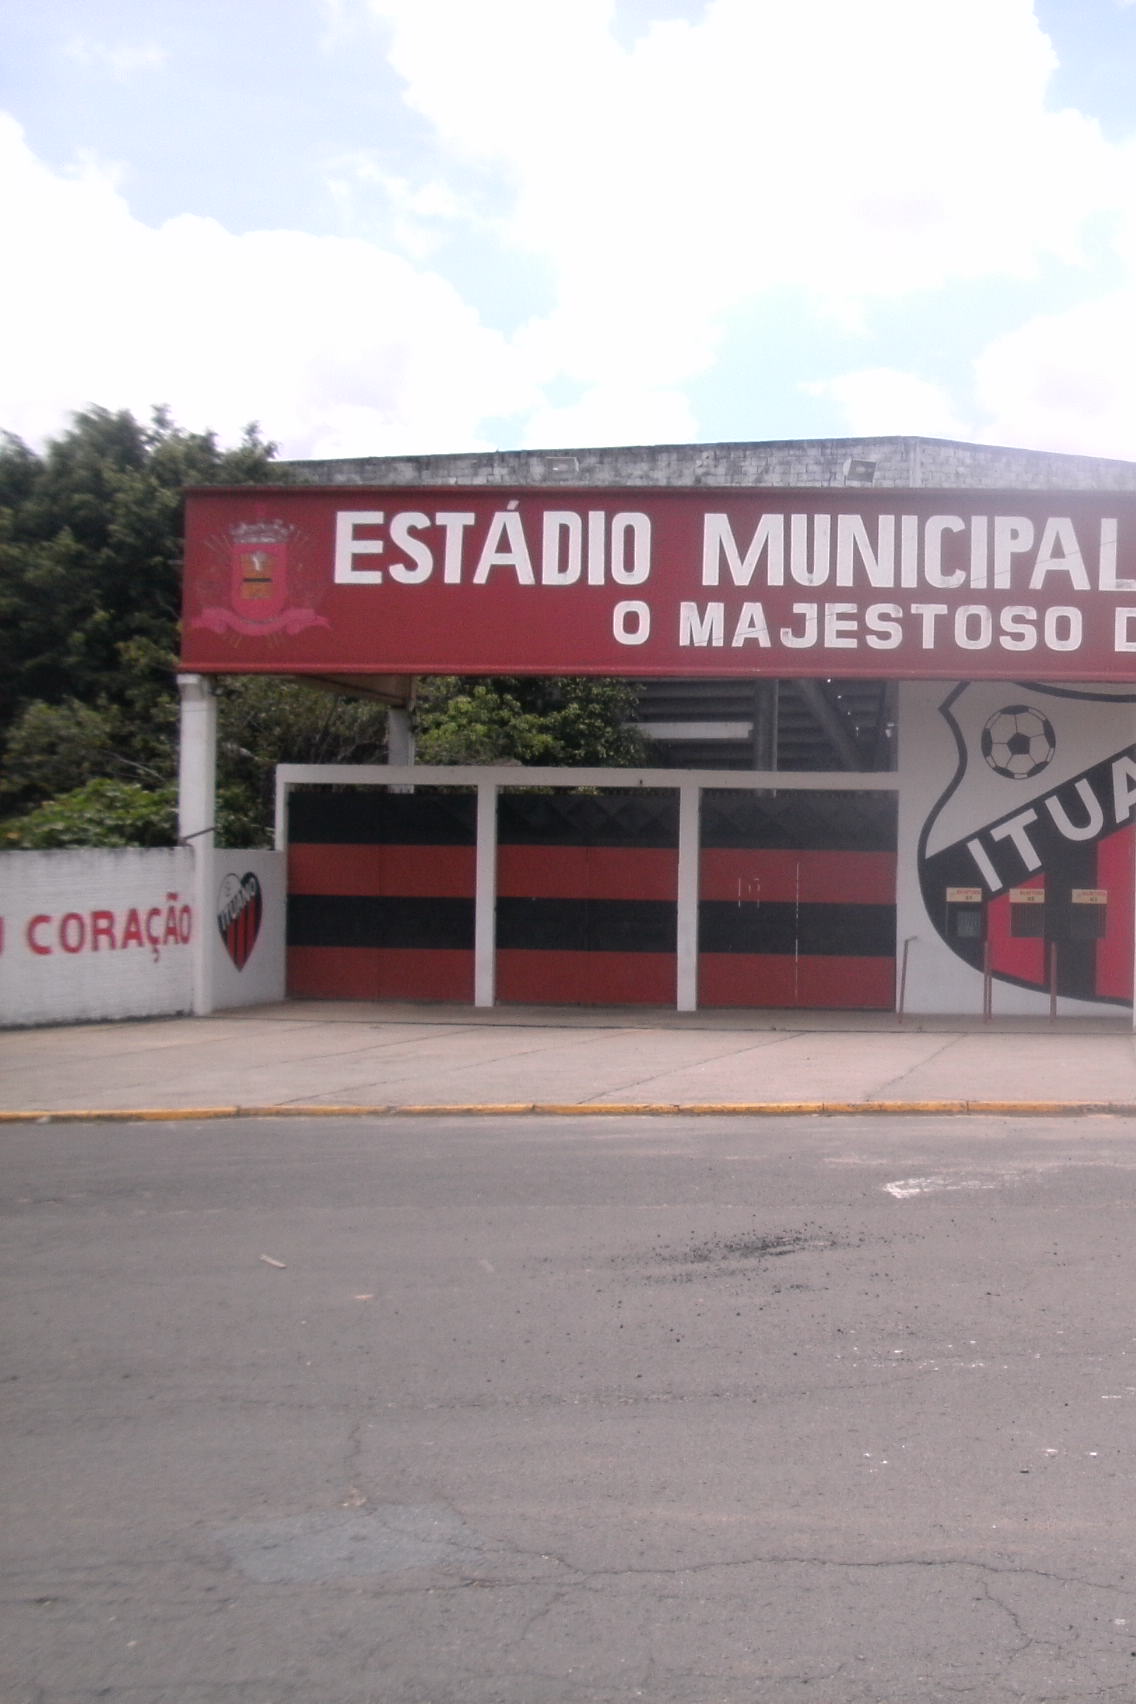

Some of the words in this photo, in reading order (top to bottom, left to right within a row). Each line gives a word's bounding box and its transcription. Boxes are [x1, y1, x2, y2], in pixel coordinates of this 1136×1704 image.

[334, 501, 652, 585] ESTÁDIO
[613, 601, 651, 646] O
[679, 602, 1083, 652] MAJESTOSO
[27, 893, 192, 963] CORAÇÃO
